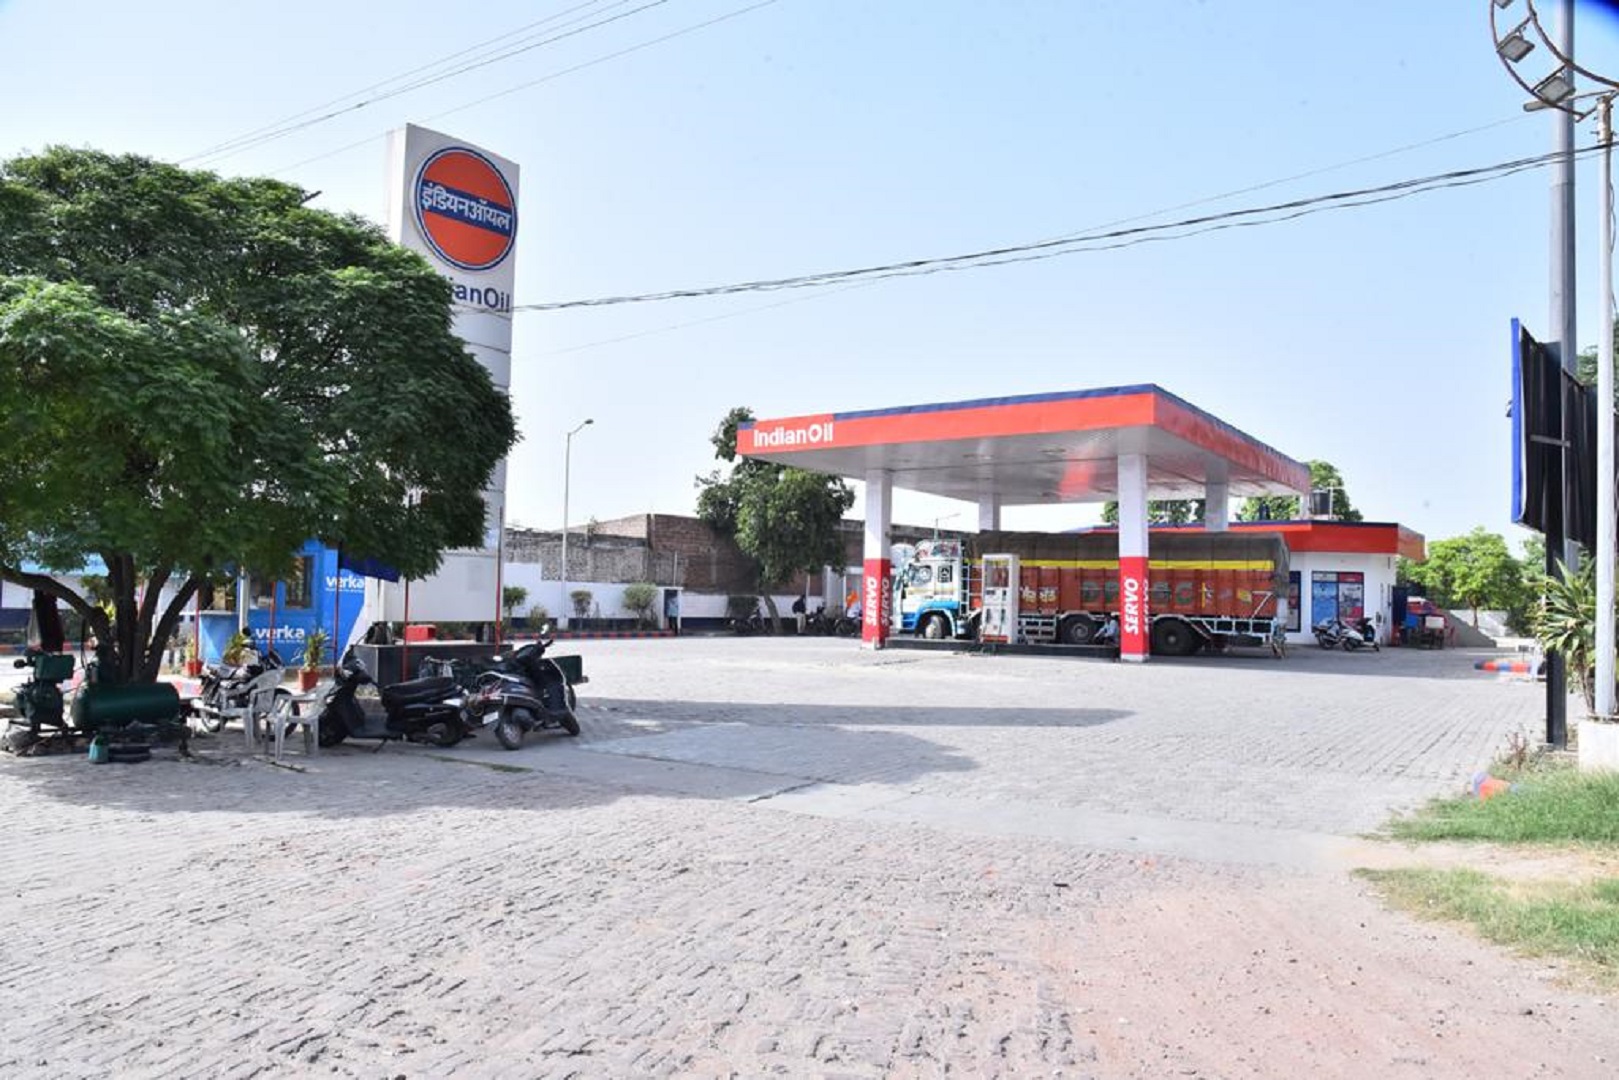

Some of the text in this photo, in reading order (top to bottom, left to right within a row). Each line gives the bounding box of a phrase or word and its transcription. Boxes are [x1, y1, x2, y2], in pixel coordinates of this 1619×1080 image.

[422, 184, 511, 230] इंडियनऑयल
[754, 423, 834, 447] IndianOil
[865, 576, 878, 626] SERVO
[1123, 577, 1139, 635] SERVO
